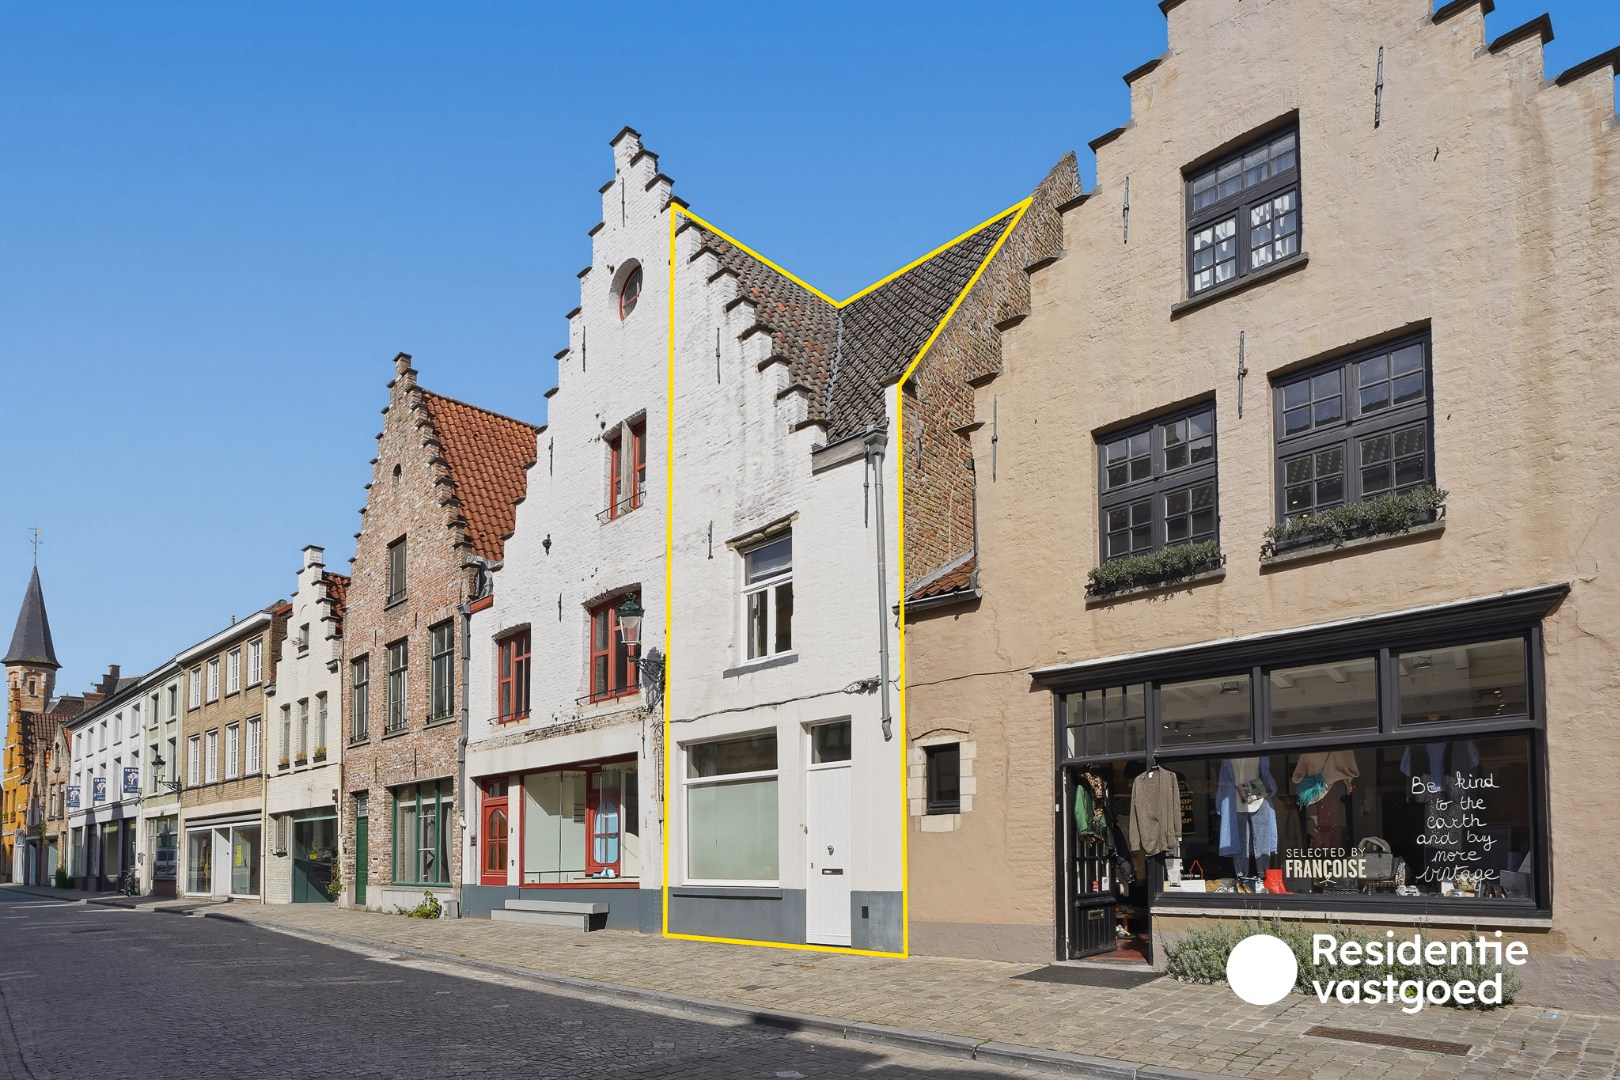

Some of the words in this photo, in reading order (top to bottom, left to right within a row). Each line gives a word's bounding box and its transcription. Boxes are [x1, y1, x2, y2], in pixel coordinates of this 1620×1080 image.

[1411, 776, 1439, 794] Be
[1455, 771, 1500, 790] kind
[1436, 798, 1453, 811] to
[1460, 796, 1486, 811] the
[1426, 814, 1487, 829] earth
[1416, 832, 1458, 845] and
[1466, 830, 1498, 852] buy
[1286, 847, 1346, 858] SELECTED
[1351, 847, 1366, 857] BY
[1431, 850, 1482, 863] more
[1415, 864, 1500, 892] vintage
